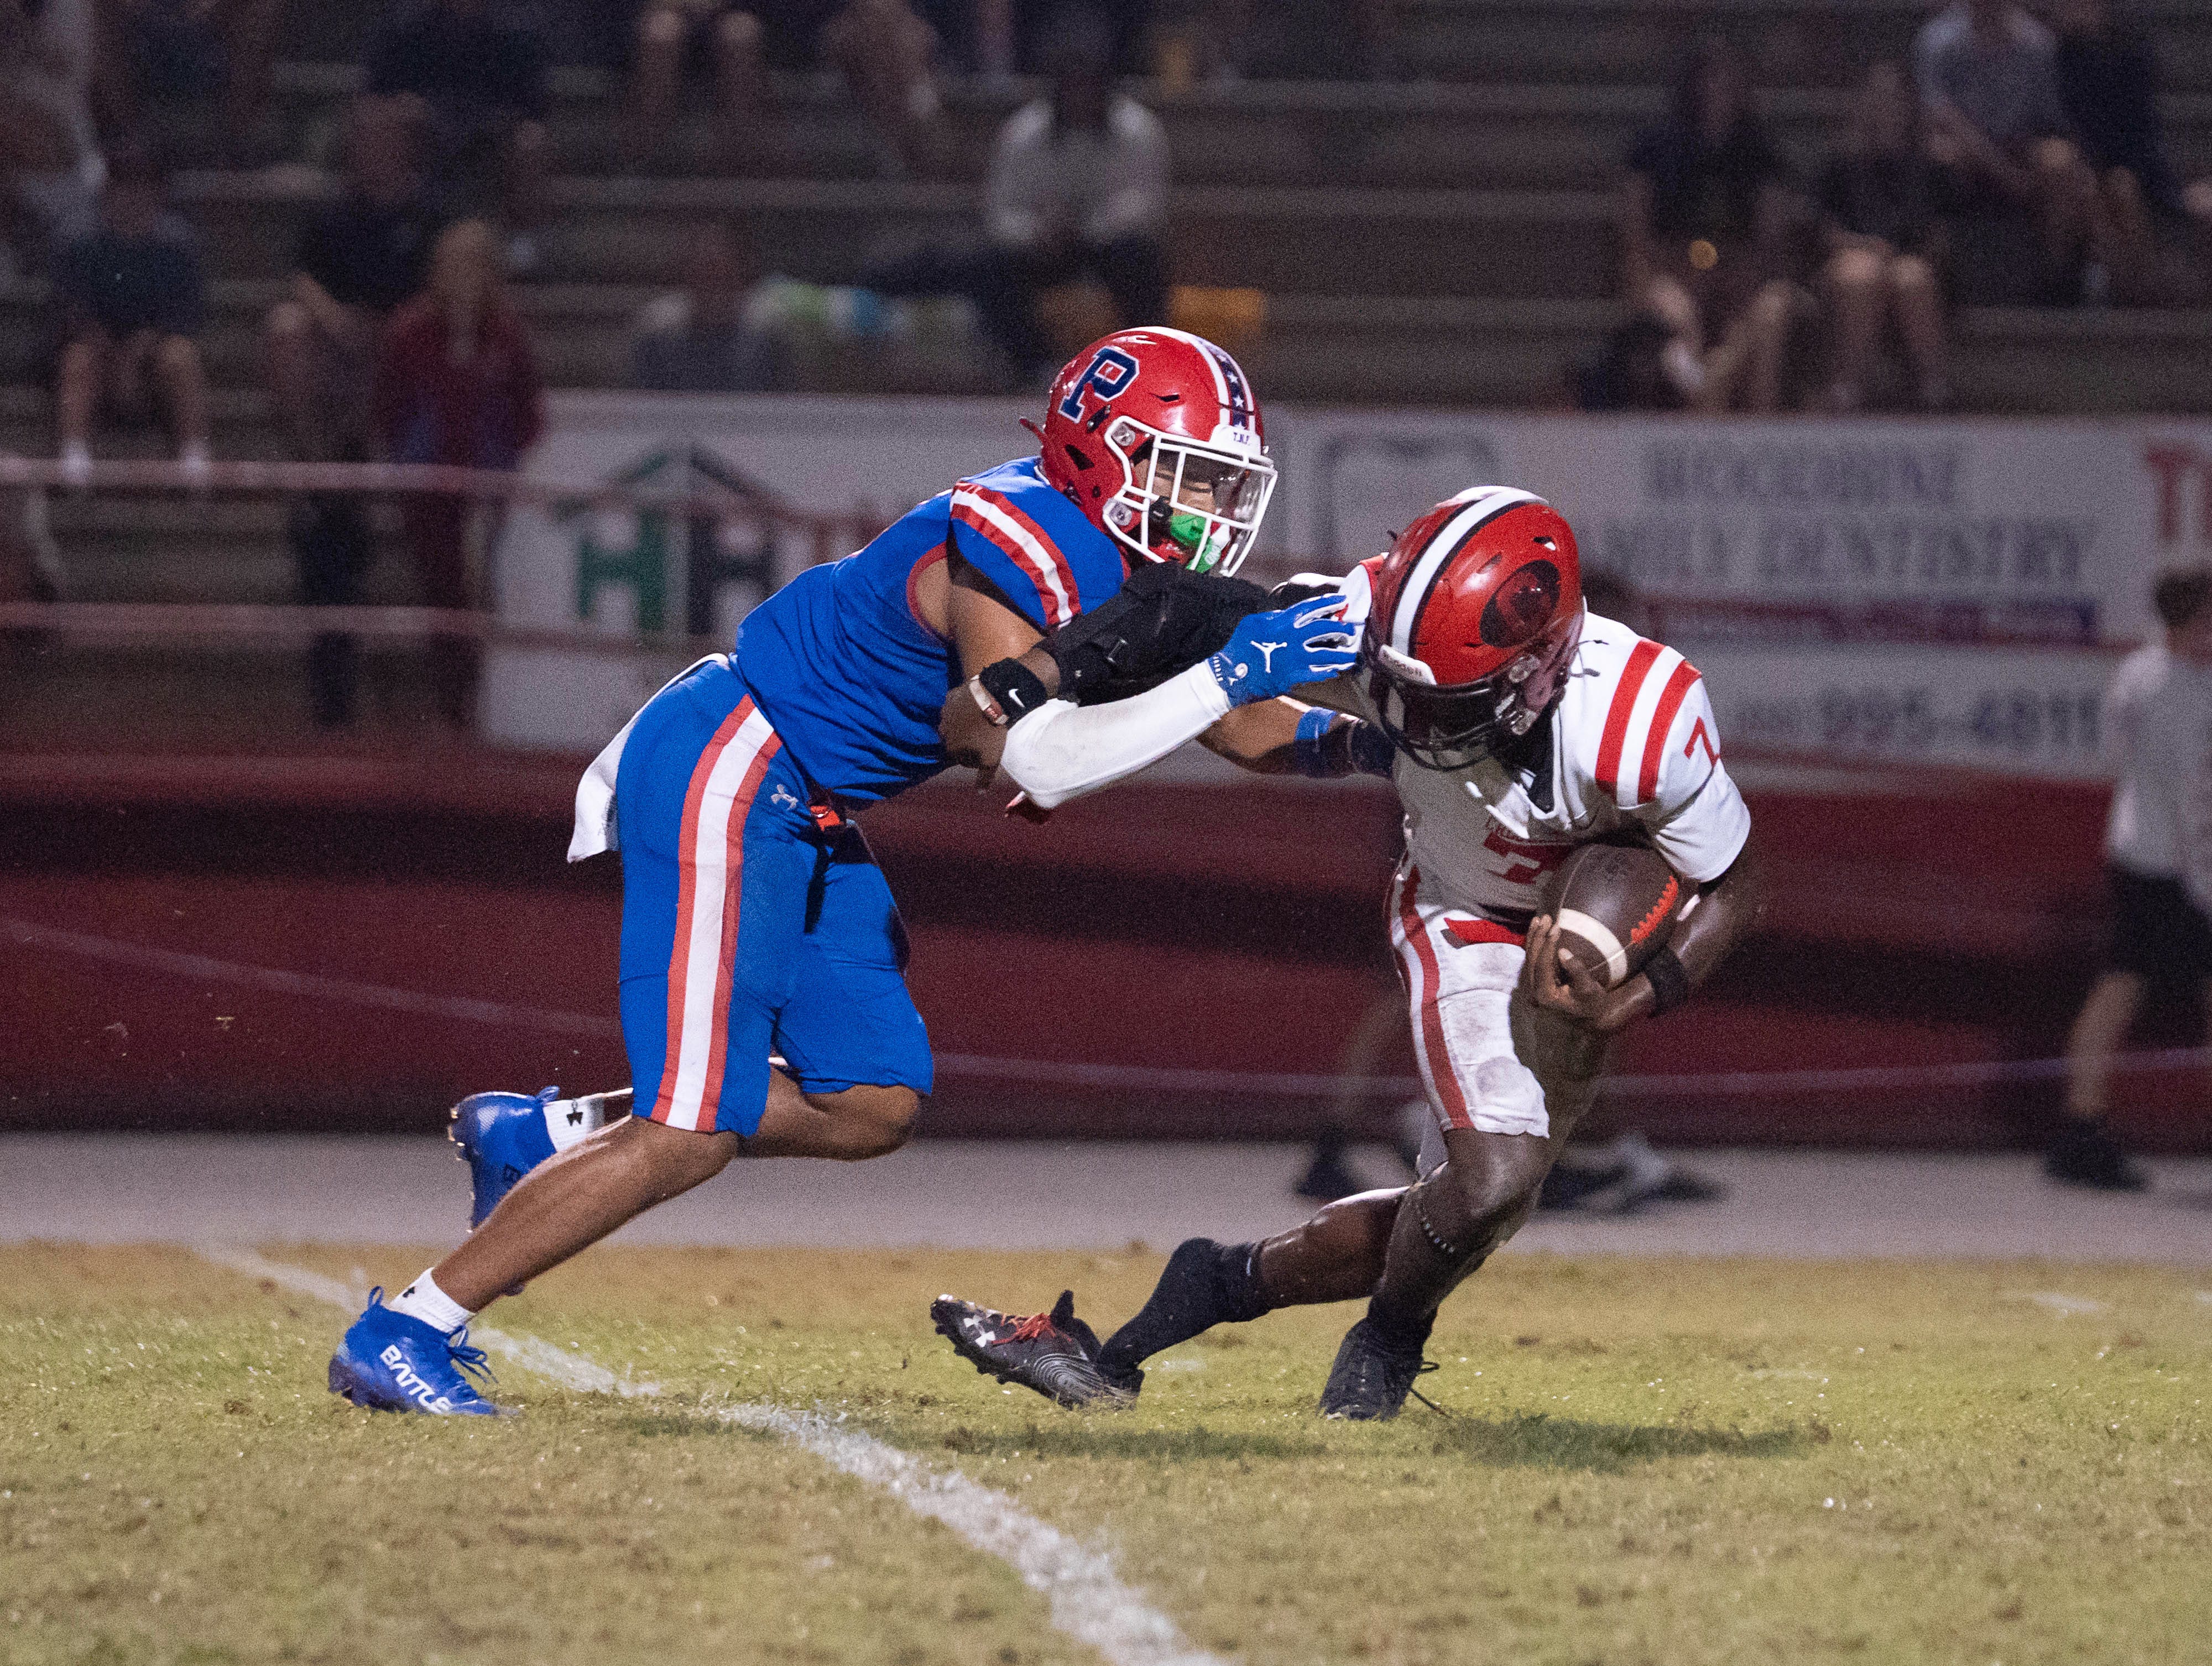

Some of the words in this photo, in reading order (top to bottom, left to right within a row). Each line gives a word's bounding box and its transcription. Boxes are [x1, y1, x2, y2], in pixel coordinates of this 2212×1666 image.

[1058, 346, 1139, 424] P
[1684, 715, 1720, 768] 7
[380, 1344, 451, 1415] BATTLE
